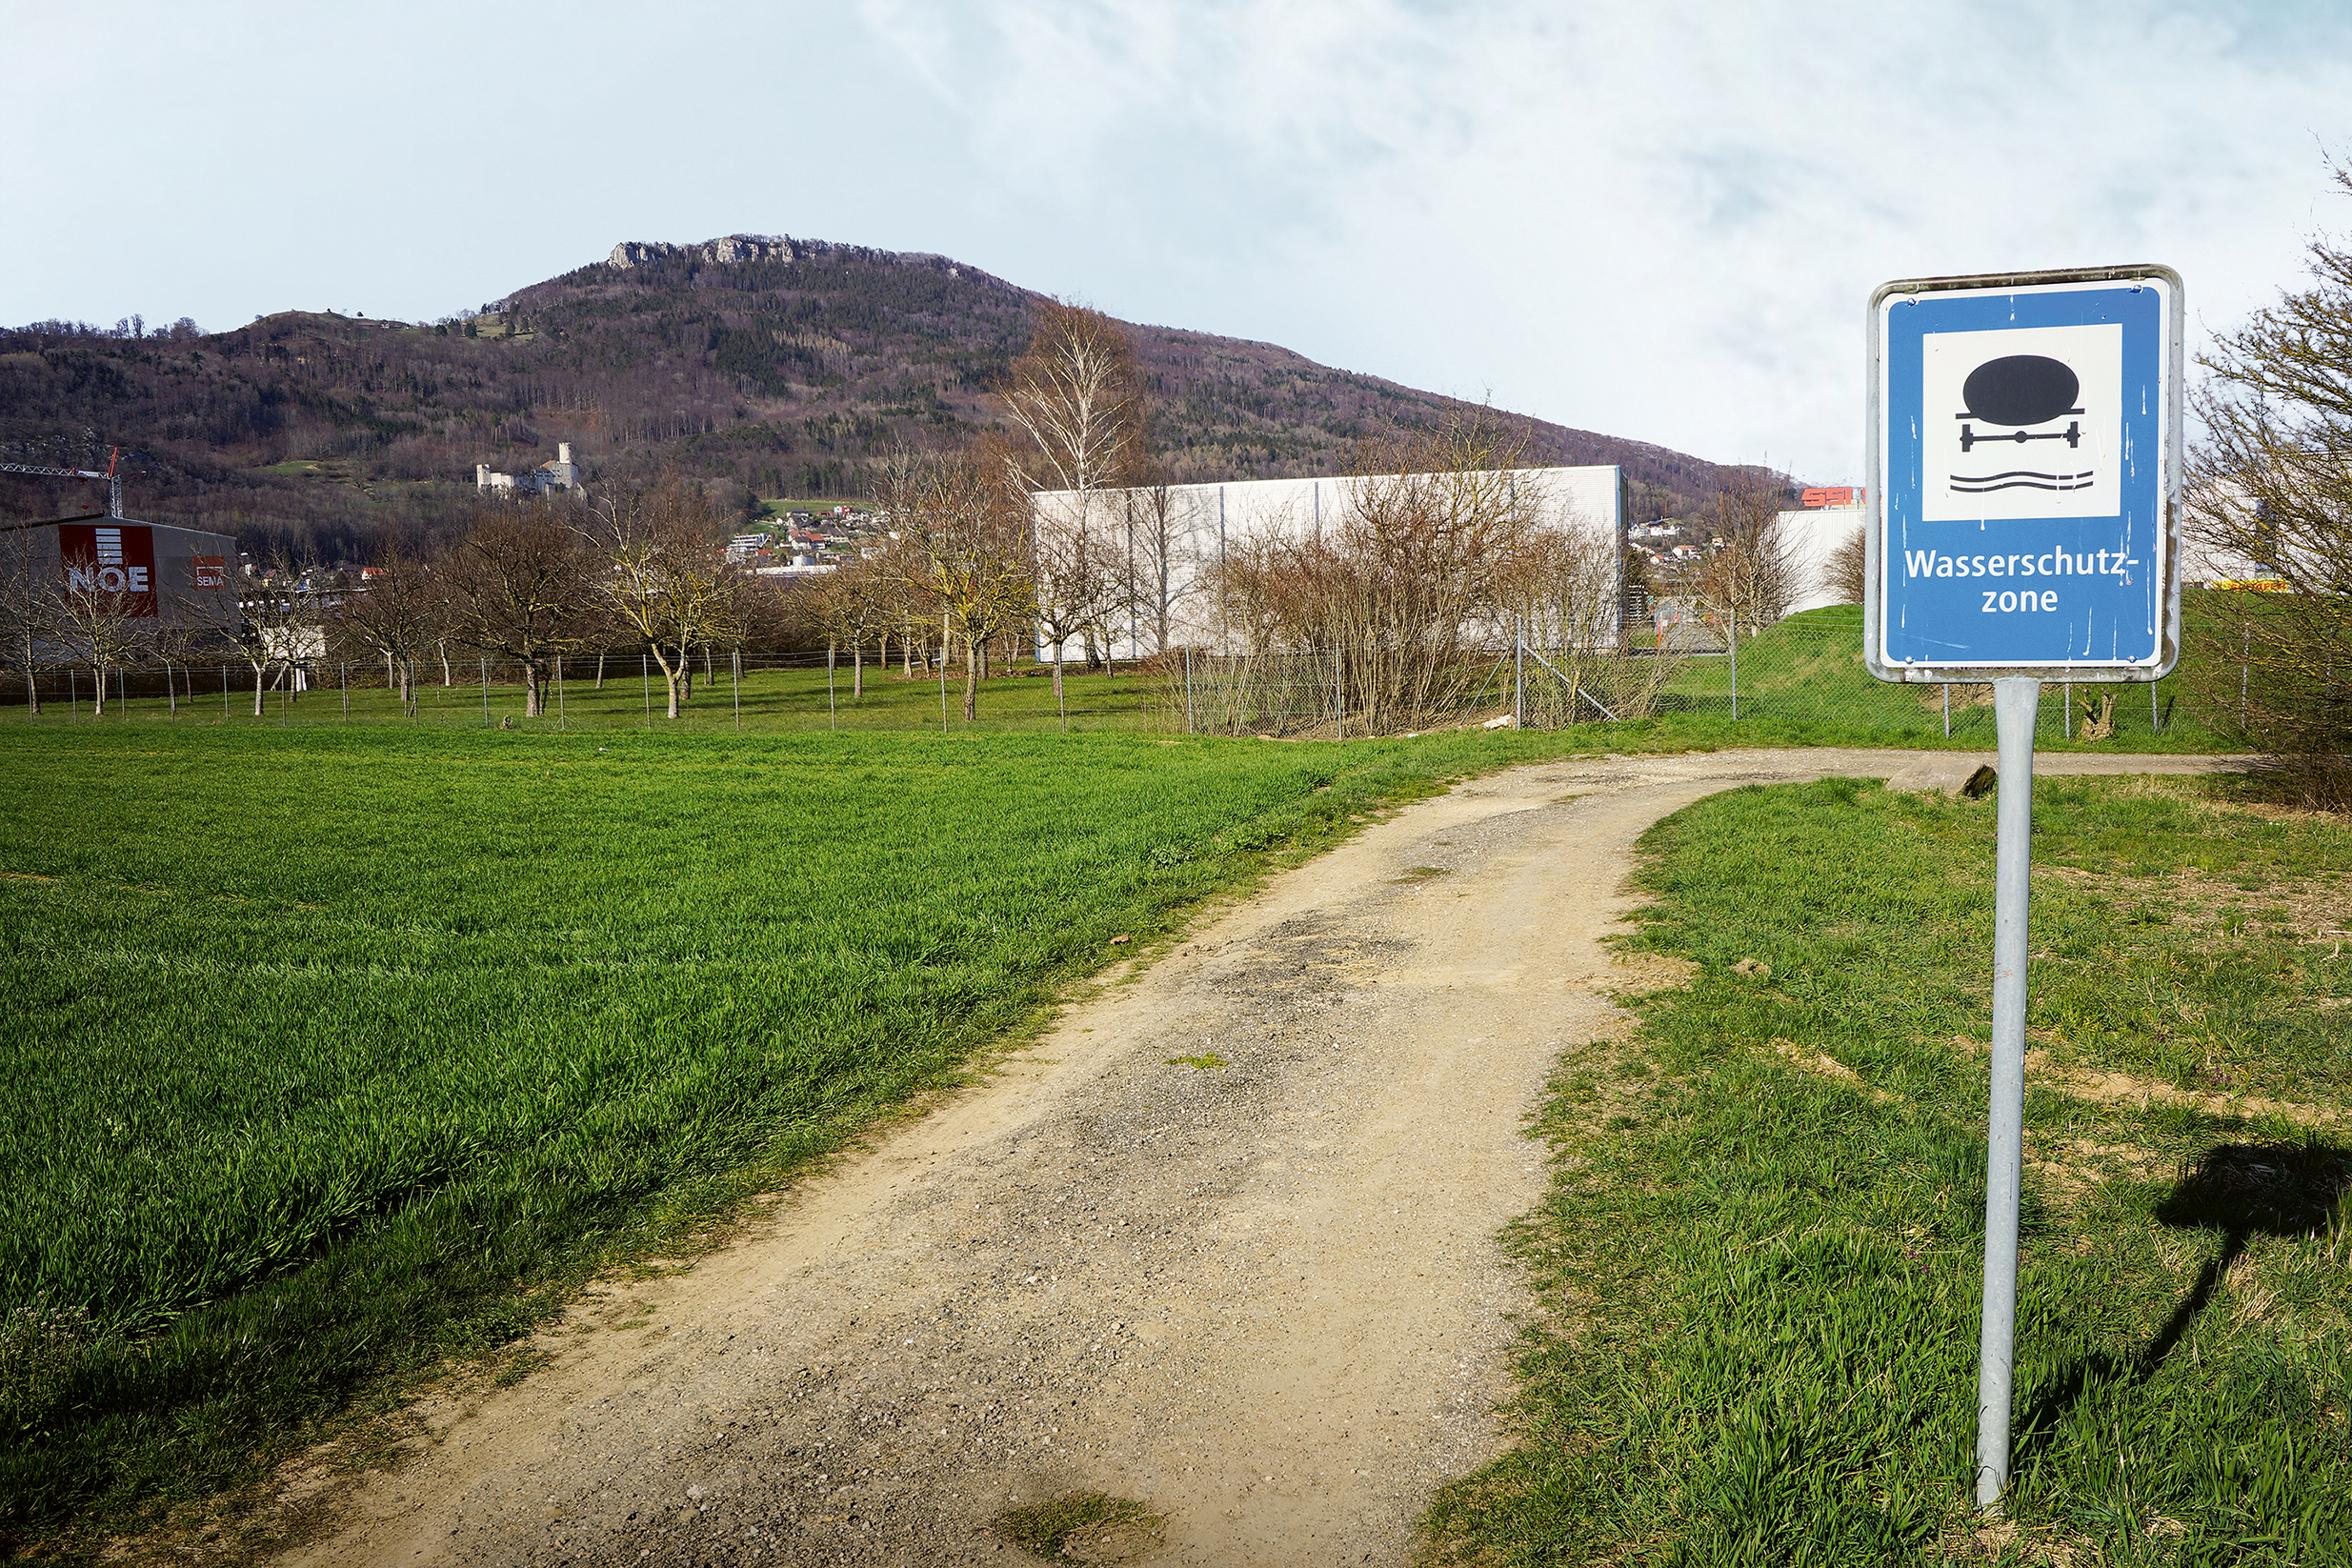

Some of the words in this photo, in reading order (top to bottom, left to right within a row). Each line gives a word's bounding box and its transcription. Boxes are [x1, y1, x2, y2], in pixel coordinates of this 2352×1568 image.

[1801, 487, 1853, 507] SSI
[1905, 545, 2139, 577] Wasserschutz-
[68, 566, 149, 592] NOE
[196, 575, 224, 587] SEMA
[1981, 589, 2059, 613] zone
